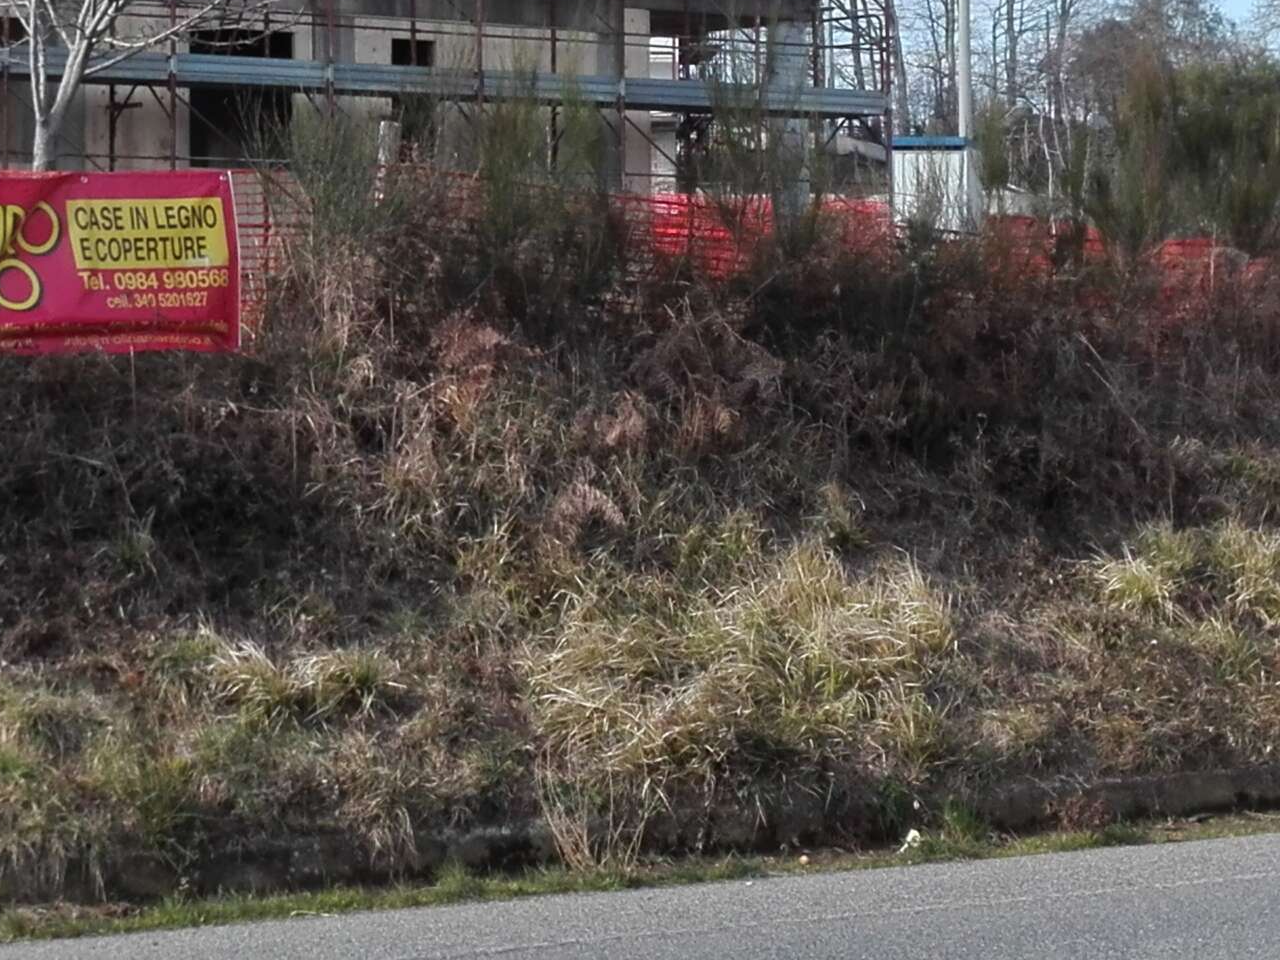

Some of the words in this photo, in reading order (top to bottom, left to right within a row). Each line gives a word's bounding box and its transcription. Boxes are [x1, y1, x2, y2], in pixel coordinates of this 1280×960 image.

[74, 206, 125, 231] CASE
[130, 207, 148, 230] IN
[153, 204, 218, 229] LEGNO
[80, 238, 93, 261] E
[95, 236, 208, 262] COPERTURE
[78, 271, 110, 290] Tel.
[114, 271, 159, 290] 0984
